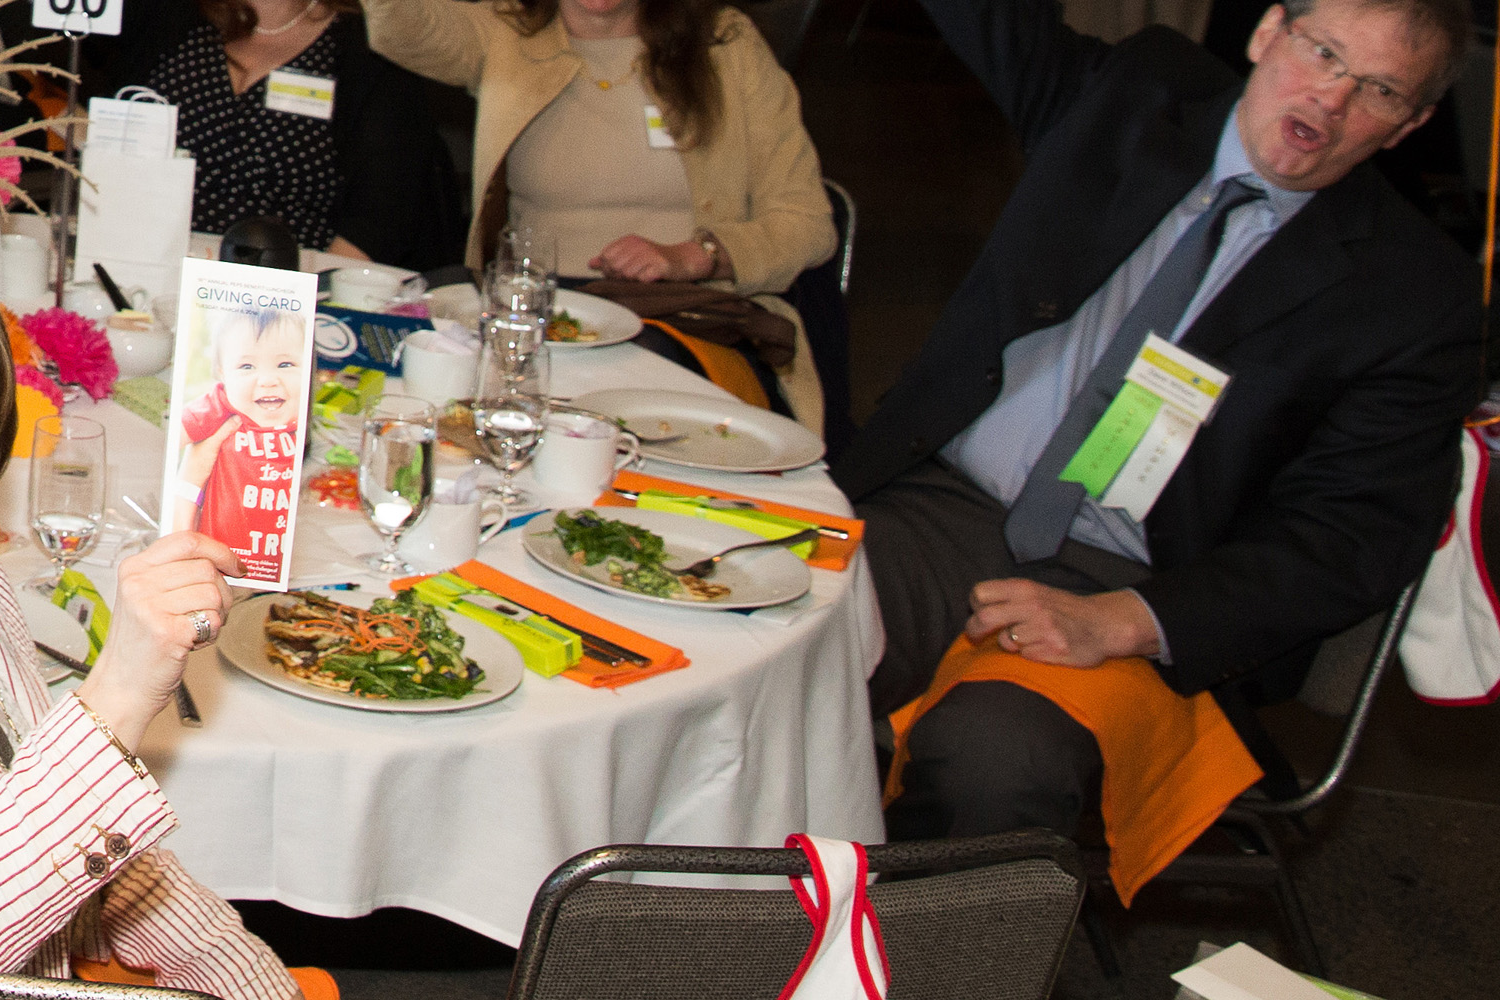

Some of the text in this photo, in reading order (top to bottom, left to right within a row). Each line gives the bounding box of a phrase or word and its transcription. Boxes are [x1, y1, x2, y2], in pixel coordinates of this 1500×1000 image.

[197, 287, 302, 312] GIVING CARD
[235, 431, 296, 459] PLED
